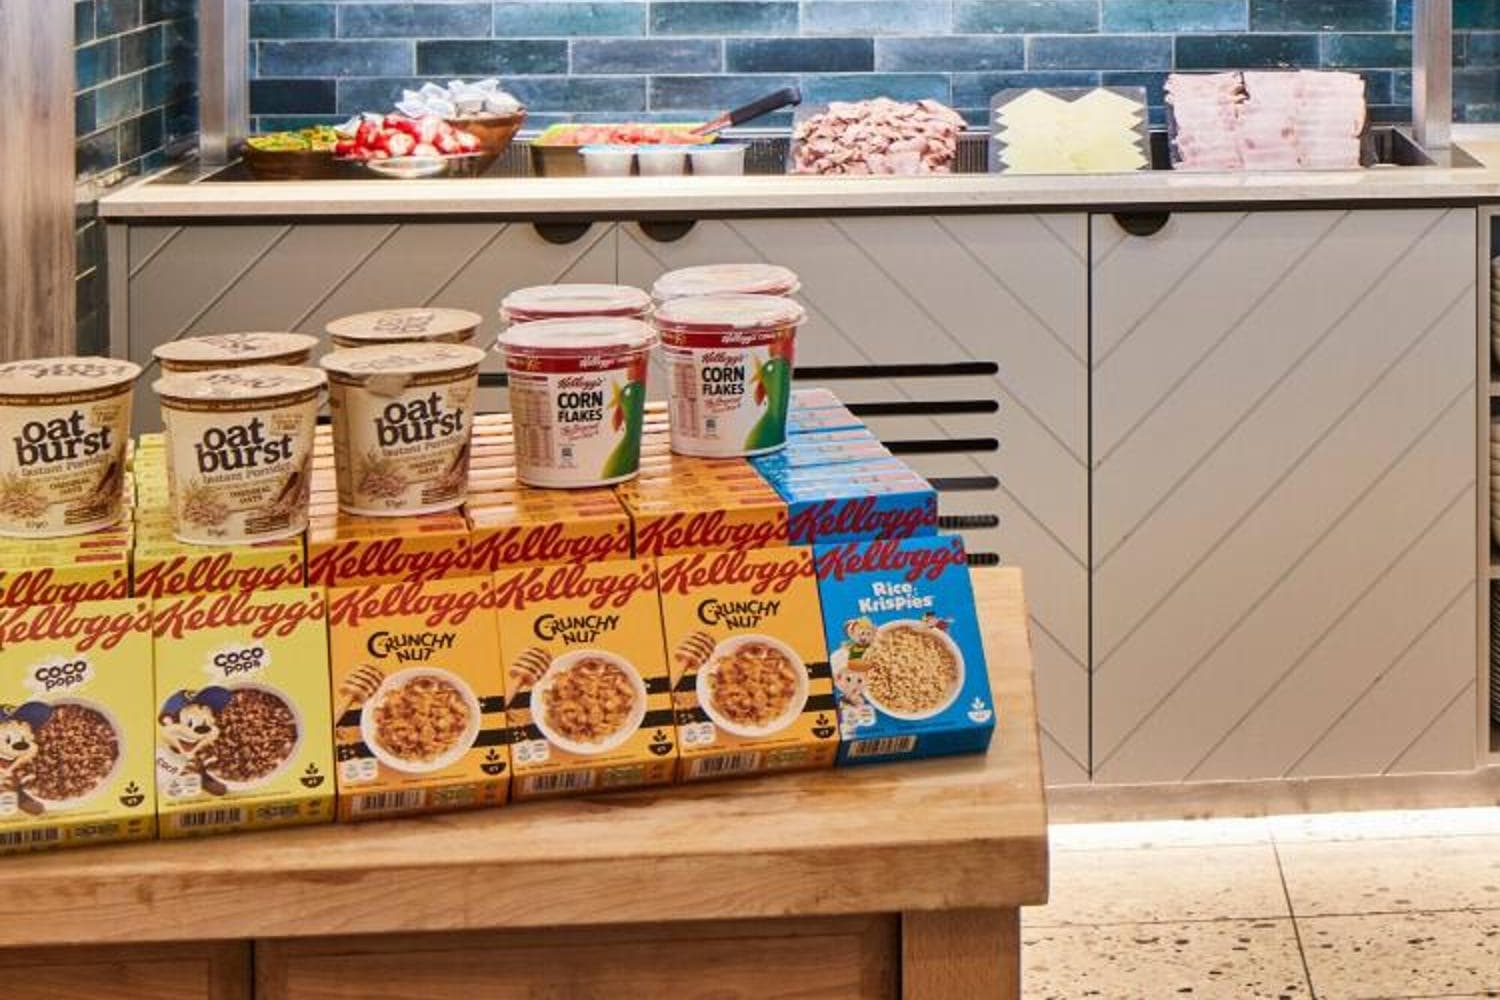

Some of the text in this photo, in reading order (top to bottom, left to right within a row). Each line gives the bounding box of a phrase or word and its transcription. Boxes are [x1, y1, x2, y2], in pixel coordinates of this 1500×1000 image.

[702, 365, 745, 383] CORN
[702, 383, 745, 396] FLAKES
[383, 391, 442, 424] oat
[557, 391, 603, 409] CORN
[557, 408, 603, 422] FLAKES
[22, 410, 85, 443] oat
[203, 416, 265, 450] oat
[374, 407, 463, 447] burst
[13, 425, 111, 466] burst
[194, 433, 293, 473] burst
[470, 522, 630, 572] Kellogg's
[637, 509, 789, 556] Kellogg's
[135, 551, 304, 598] Kellogg's
[309, 537, 472, 587] Kellogg's
[661, 550, 816, 596] Kellogg's
[817, 538, 967, 582] Kellogg's
[0, 567, 128, 608] llogg's
[495, 563, 658, 610] Kellogg's
[871, 581, 914, 597] Rice
[154, 591, 325, 639] Kellogg's
[329, 579, 496, 628] Kellogg's
[697, 598, 781, 626] CRUNCHY
[858, 594, 934, 614] Krispies
[533, 613, 620, 641] CRUNCHY
[562, 629, 602, 646] NUT
[725, 614, 763, 631] NUT
[367, 631, 456, 659] CRUNCHY
[395, 647, 437, 663] NUT
